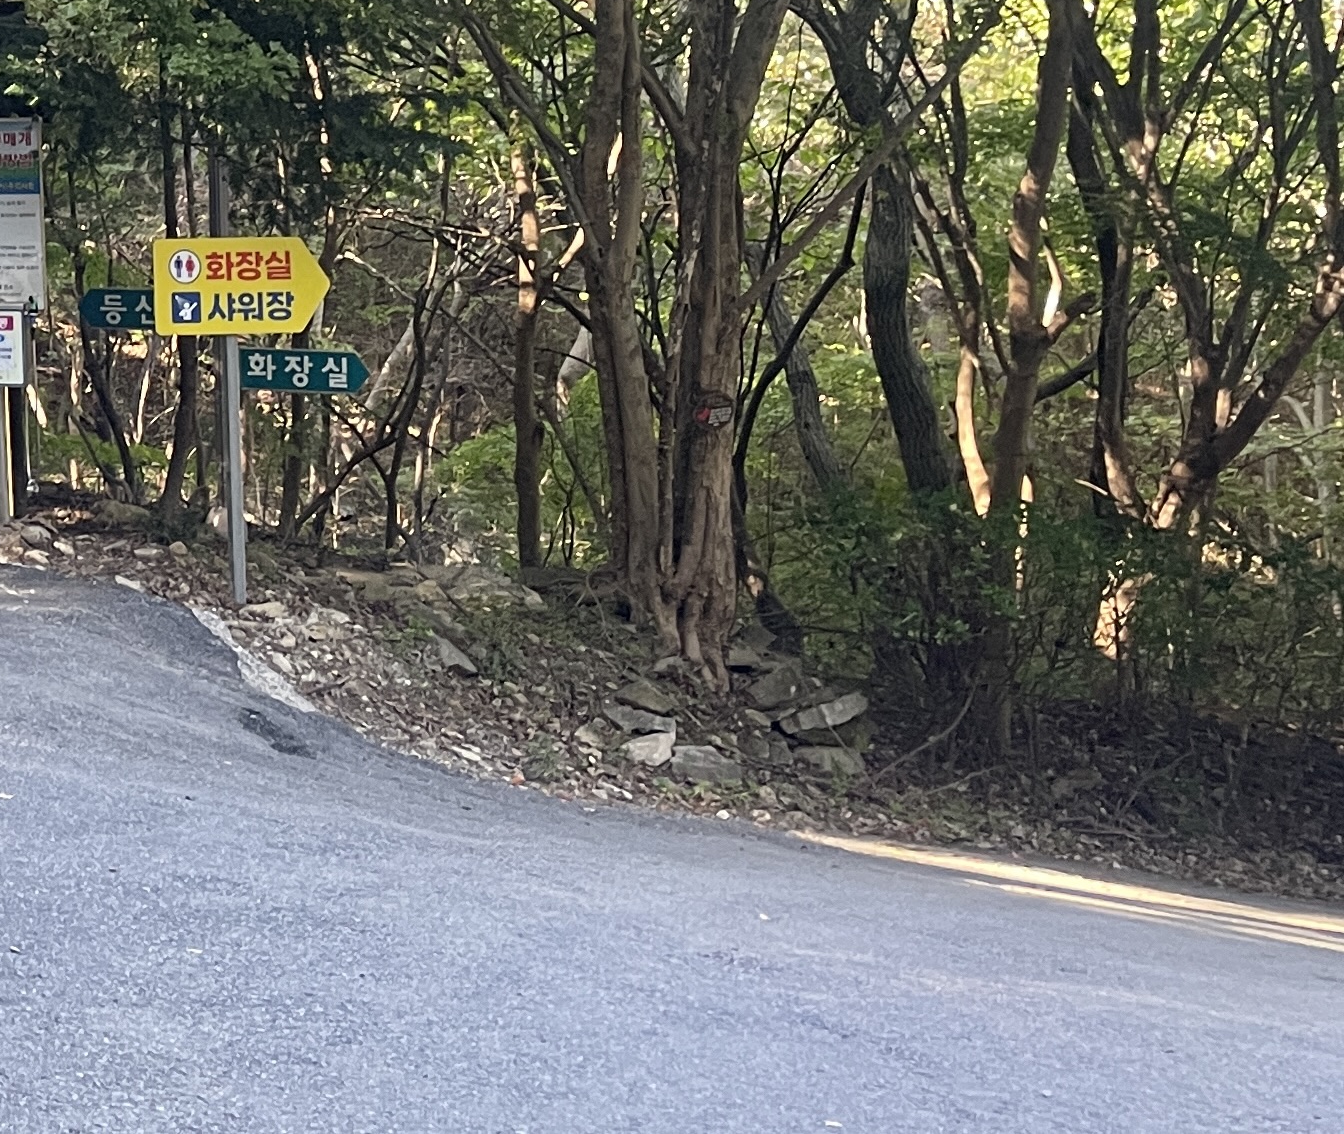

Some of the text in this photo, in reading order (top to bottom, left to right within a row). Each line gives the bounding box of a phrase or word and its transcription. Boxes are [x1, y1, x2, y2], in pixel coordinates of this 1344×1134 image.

[205, 250, 292, 281] 화장실
[208, 291, 294, 322] 샤워장
[247, 352, 349, 389] 화장실
